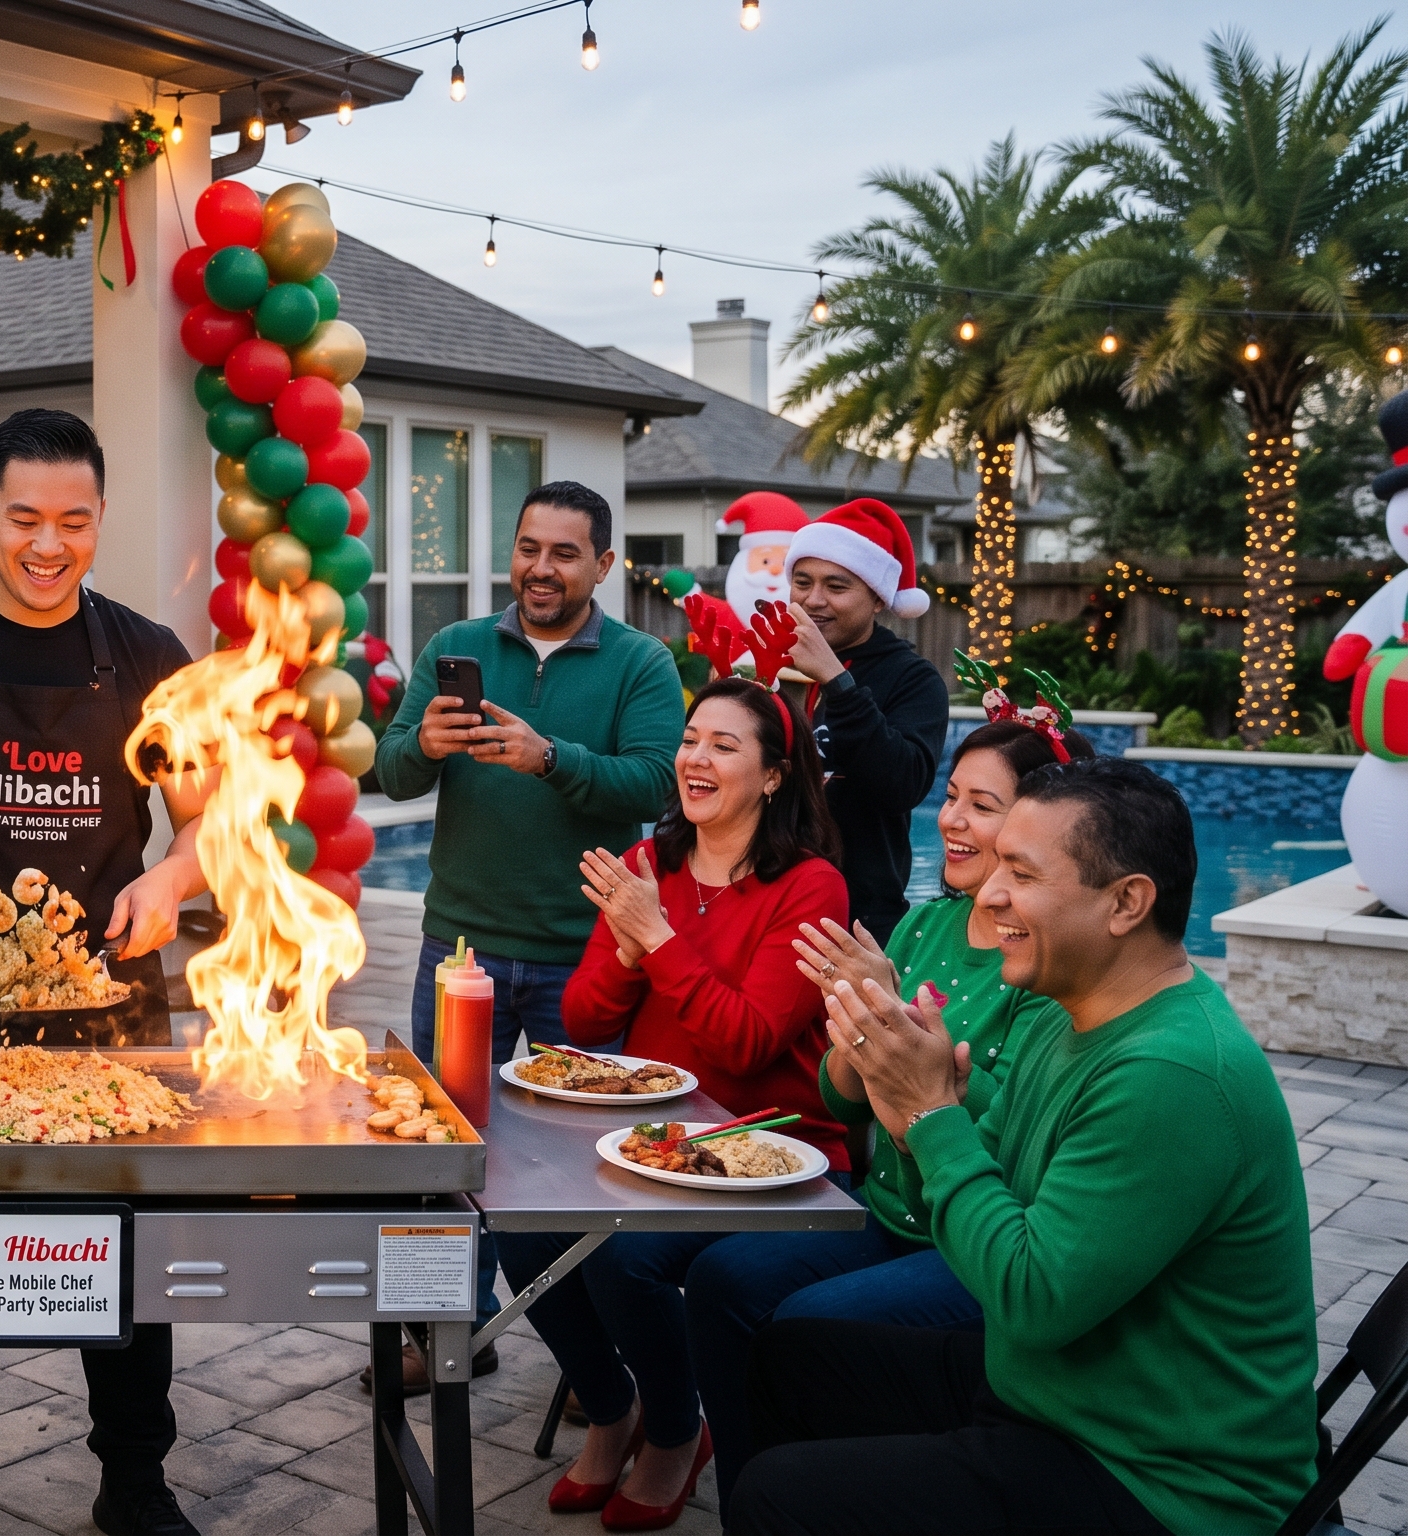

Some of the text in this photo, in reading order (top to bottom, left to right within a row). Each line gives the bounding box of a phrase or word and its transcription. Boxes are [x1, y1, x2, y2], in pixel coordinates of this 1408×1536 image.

[25, 816, 70, 828] MOBILE
[72, 817, 102, 828] CHEF
[10, 829, 68, 841] HOUSTON
[4, 1235, 110, 1262] Hibachi
[9, 1274, 56, 1290] Mobile
[61, 1274, 94, 1290] Chef
[39, 1295, 109, 1316] Specialist
